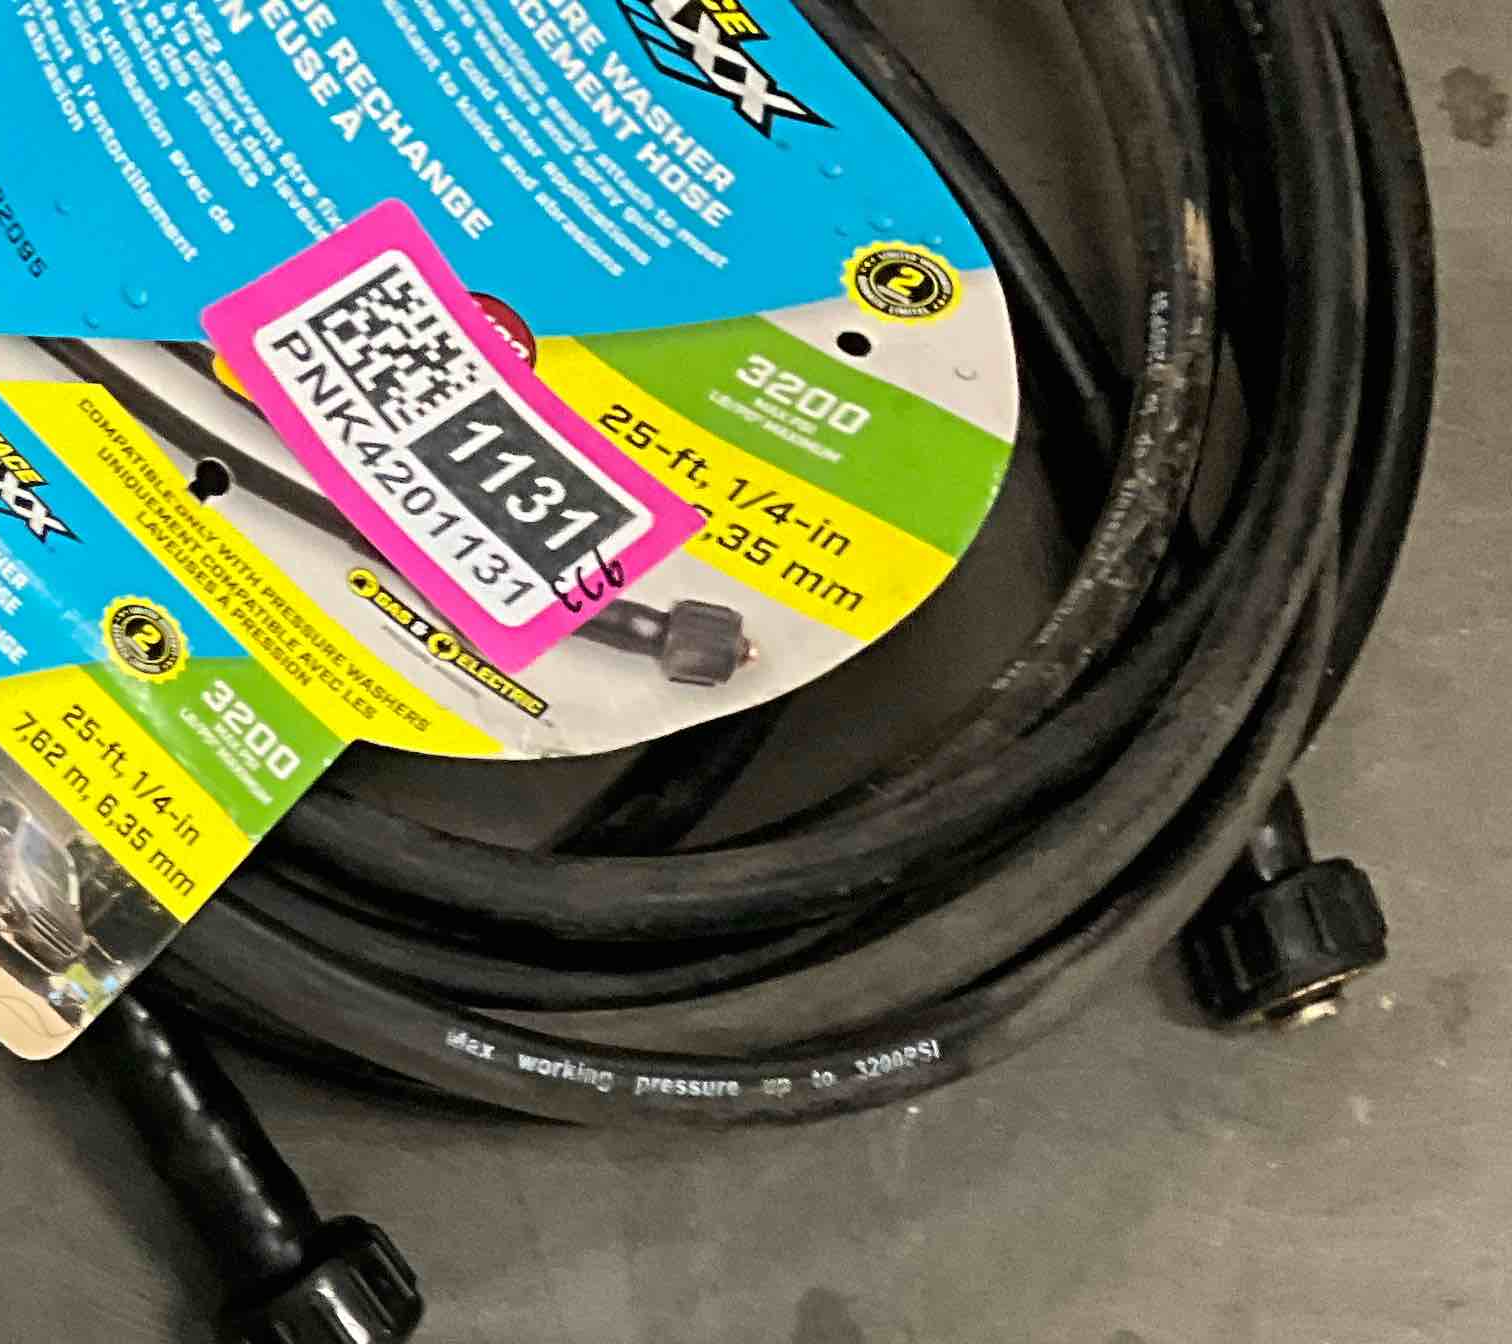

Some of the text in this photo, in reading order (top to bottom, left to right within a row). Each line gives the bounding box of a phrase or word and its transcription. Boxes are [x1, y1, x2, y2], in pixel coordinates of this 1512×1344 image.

[98, 26, 173, 149] utilisation
[168, 149, 213, 204] avec
[208, 204, 236, 235] de
[143, 12, 167, 41] et
[159, 43, 193, 88] des
[185, 90, 259, 189] pistolets
[170, 19, 192, 46] la
[184, 49, 248, 135] plupart
[242, 134, 276, 177] des
[215, 60, 284, 152] peuvent
[315, 197, 348, 232] fix
[325, 36, 494, 240] RECHANGE
[330, 97, 366, 142] À
[437, 71, 460, 97] to
[453, 94, 504, 152] kinks
[499, 153, 540, 192] and
[534, 191, 625, 277] abrasions
[440, 31, 463, 56] in
[458, 57, 500, 101] cold
[493, 101, 546, 158] water
[541, 161, 652, 266] applications
[473, 28, 542, 117] washers
[538, 117, 577, 155] and
[572, 154, 624, 208] spray
[622, 206, 673, 248] guns
[509, 0, 734, 228] CEMENT HOSE
[545, 95, 598, 152] easily
[594, 153, 655, 211] attach
[654, 208, 678, 231] to
[676, 228, 729, 268] most
[601, 51, 736, 192] WASHER
[887, 266, 925, 297] 2
[272, 330, 536, 607] PNK4201131
[598, 403, 853, 557] 25-ft, 1/4-in
[735, 353, 872, 437] 3200
[78, 396, 179, 506] COMPATIBLE
[174, 501, 223, 549] ONLY
[218, 543, 266, 589] WITH
[261, 583, 347, 670] PRESSURE
[347, 664, 432, 734] WASHERS
[448, 419, 600, 551] 1131
[693, 502, 866, 613] ,35 mm
[96, 445, 203, 555] UNIQUEMENT
[199, 552, 301, 659] COMPATIBLE
[298, 651, 345, 693] AVEC
[342, 686, 379, 721] LES
[130, 622, 162, 653] 2
[136, 511, 219, 593] LAVEUSES
[230, 607, 313, 689] PRESSION
[12, 710, 198, 898] 7,62 m, 6,35 mm
[61, 703, 201, 847] 25-ft, 1/4-in
[200, 677, 301, 782] 3200
[516, 1051, 616, 1093] working
[632, 1073, 743, 1099] pressure
[760, 1076, 793, 1100] up
[809, 1067, 836, 1088] to
[853, 1038, 942, 1080] 3200PSI
